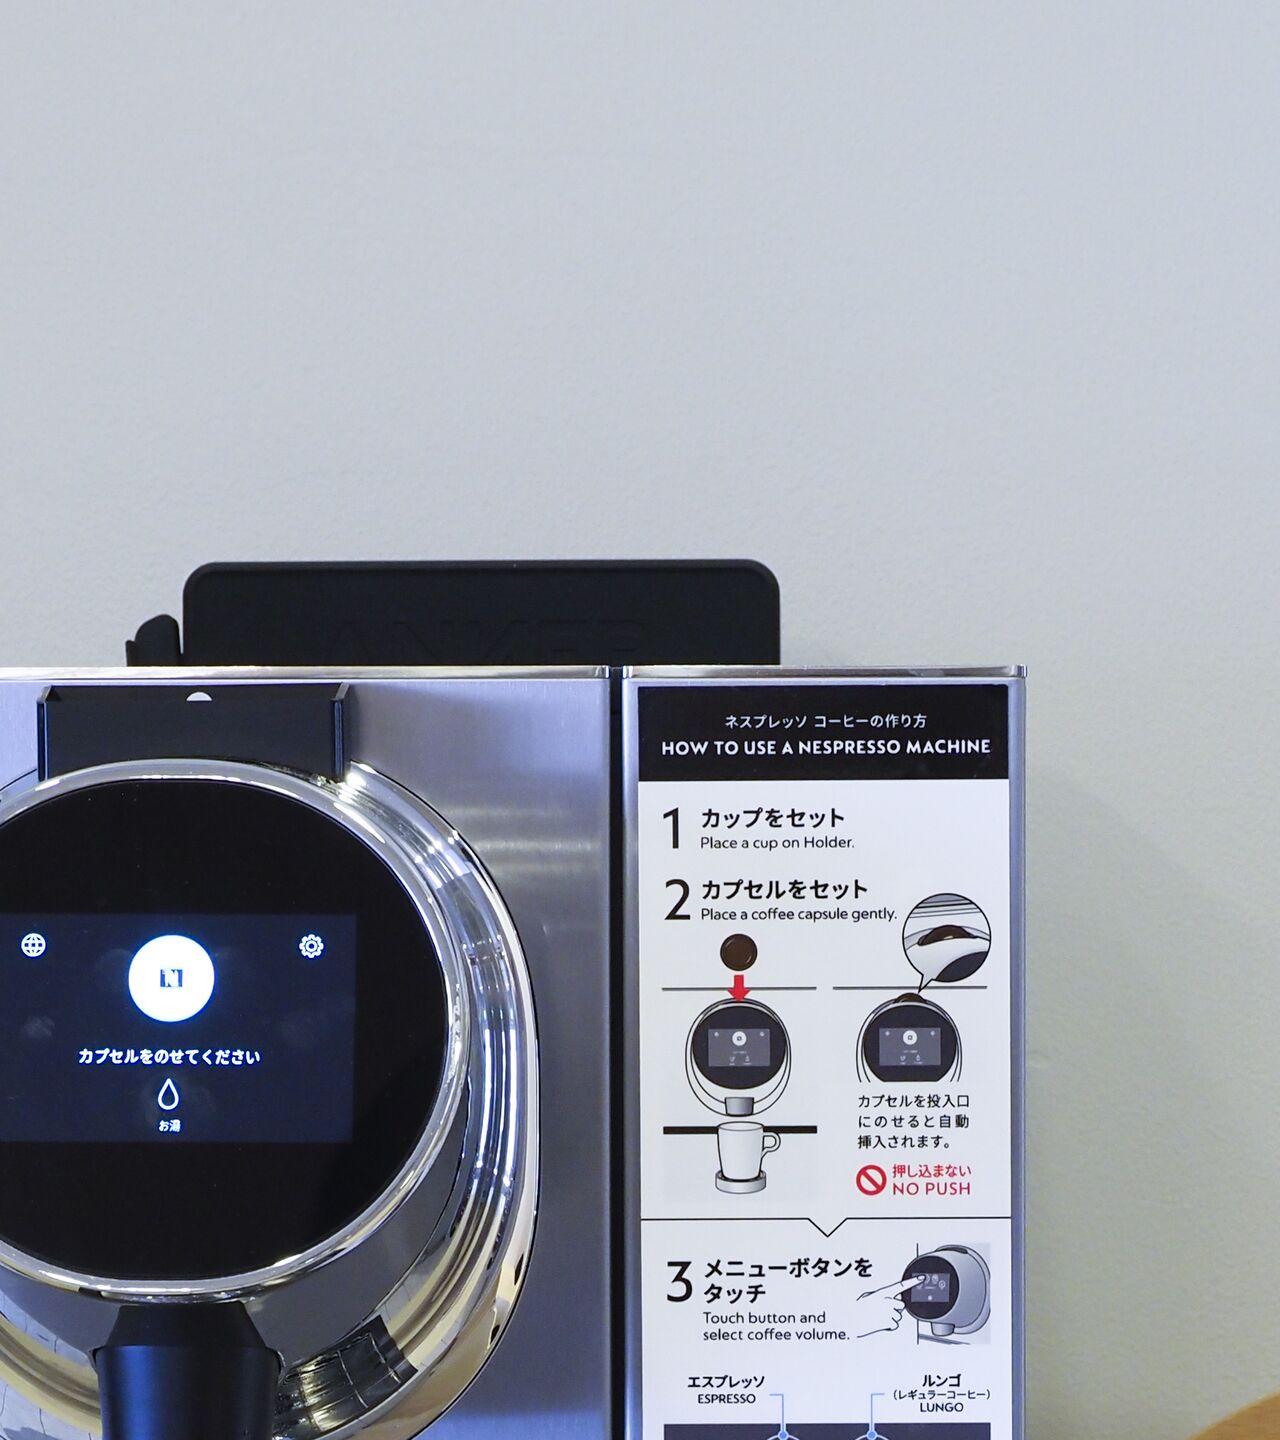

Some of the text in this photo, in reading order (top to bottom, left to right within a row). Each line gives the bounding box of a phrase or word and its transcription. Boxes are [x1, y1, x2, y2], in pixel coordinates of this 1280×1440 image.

[725, 713, 927, 729] ネスプレッソ コーヒーの作り方
[662, 739, 991, 756] HOW TO USE A NESPRESSO MACHINE
[701, 808, 845, 829] カップをセット
[663, 808, 680, 849] 1
[700, 836, 854, 852] Place a cup on Holder.
[701, 879, 867, 900] カプセルをセット
[664, 879, 691, 920] 2
[701, 908, 897, 923] Place a coffee capsule gently.
[78, 1048, 260, 1065] カプセルをのせてください
[858, 1094, 969, 1108] カプセルを投入口
[159, 1119, 180, 1132] お湯
[858, 1114, 969, 1129] にのせると自動
[858, 1135, 950, 1149] 挿入されます。
[892, 1164, 971, 1178] 押し込まない
[892, 1182, 970, 1195] NO PUSH
[704, 1259, 872, 1278] メニューボタンを
[667, 1261, 692, 1302] 3
[704, 1284, 766, 1303] タッチ
[703, 1312, 826, 1324] Touch button and
[703, 1328, 850, 1341] select coffee volume.
[688, 1376, 765, 1388] エスプレッソ
[922, 1374, 961, 1387] ルンゴ
[698, 1393, 756, 1404] ESPRESSO
[920, 1402, 963, 1413] LUNGO
